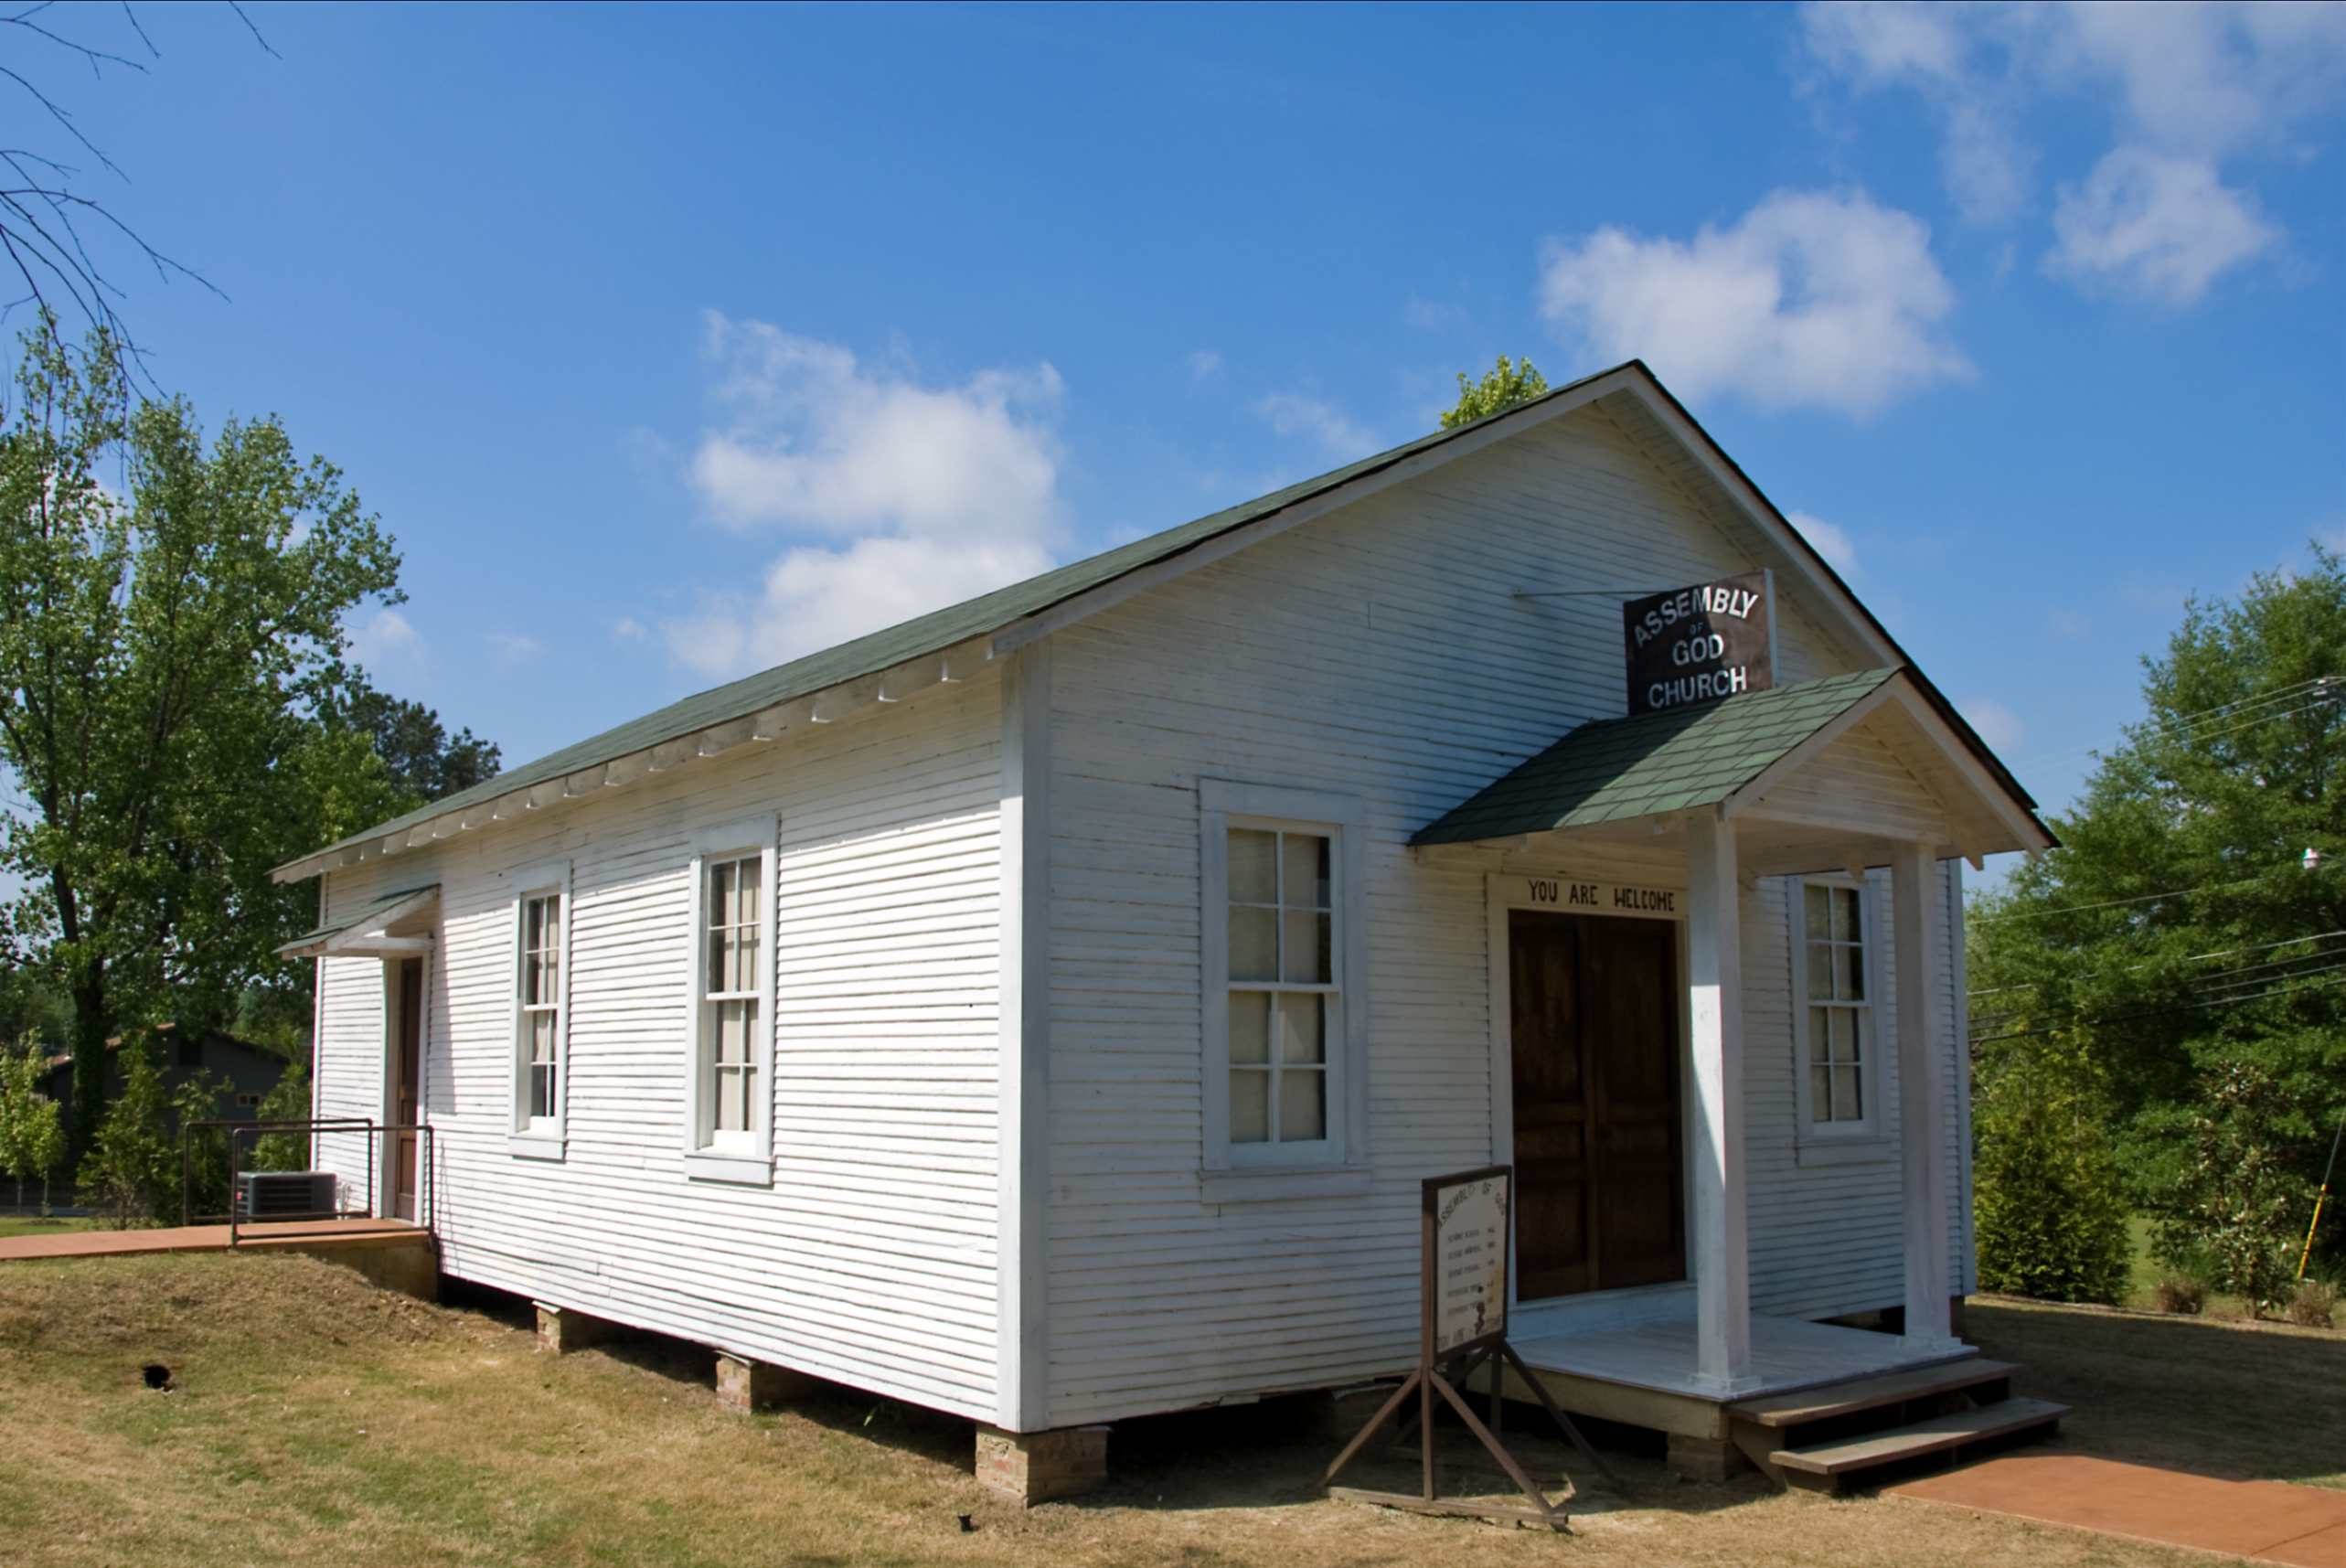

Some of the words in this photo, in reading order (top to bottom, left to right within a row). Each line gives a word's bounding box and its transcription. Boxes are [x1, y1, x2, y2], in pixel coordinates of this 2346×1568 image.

[1634, 586, 1758, 646] ASSEMBLY
[1690, 622, 1704, 635] OF
[1673, 634, 1723, 666] GOD
[1648, 667, 1747, 708] CHURCH
[1528, 880, 1558, 902] YOU
[1569, 884, 1598, 906] ARE
[1614, 888, 1675, 912] WELCOME
